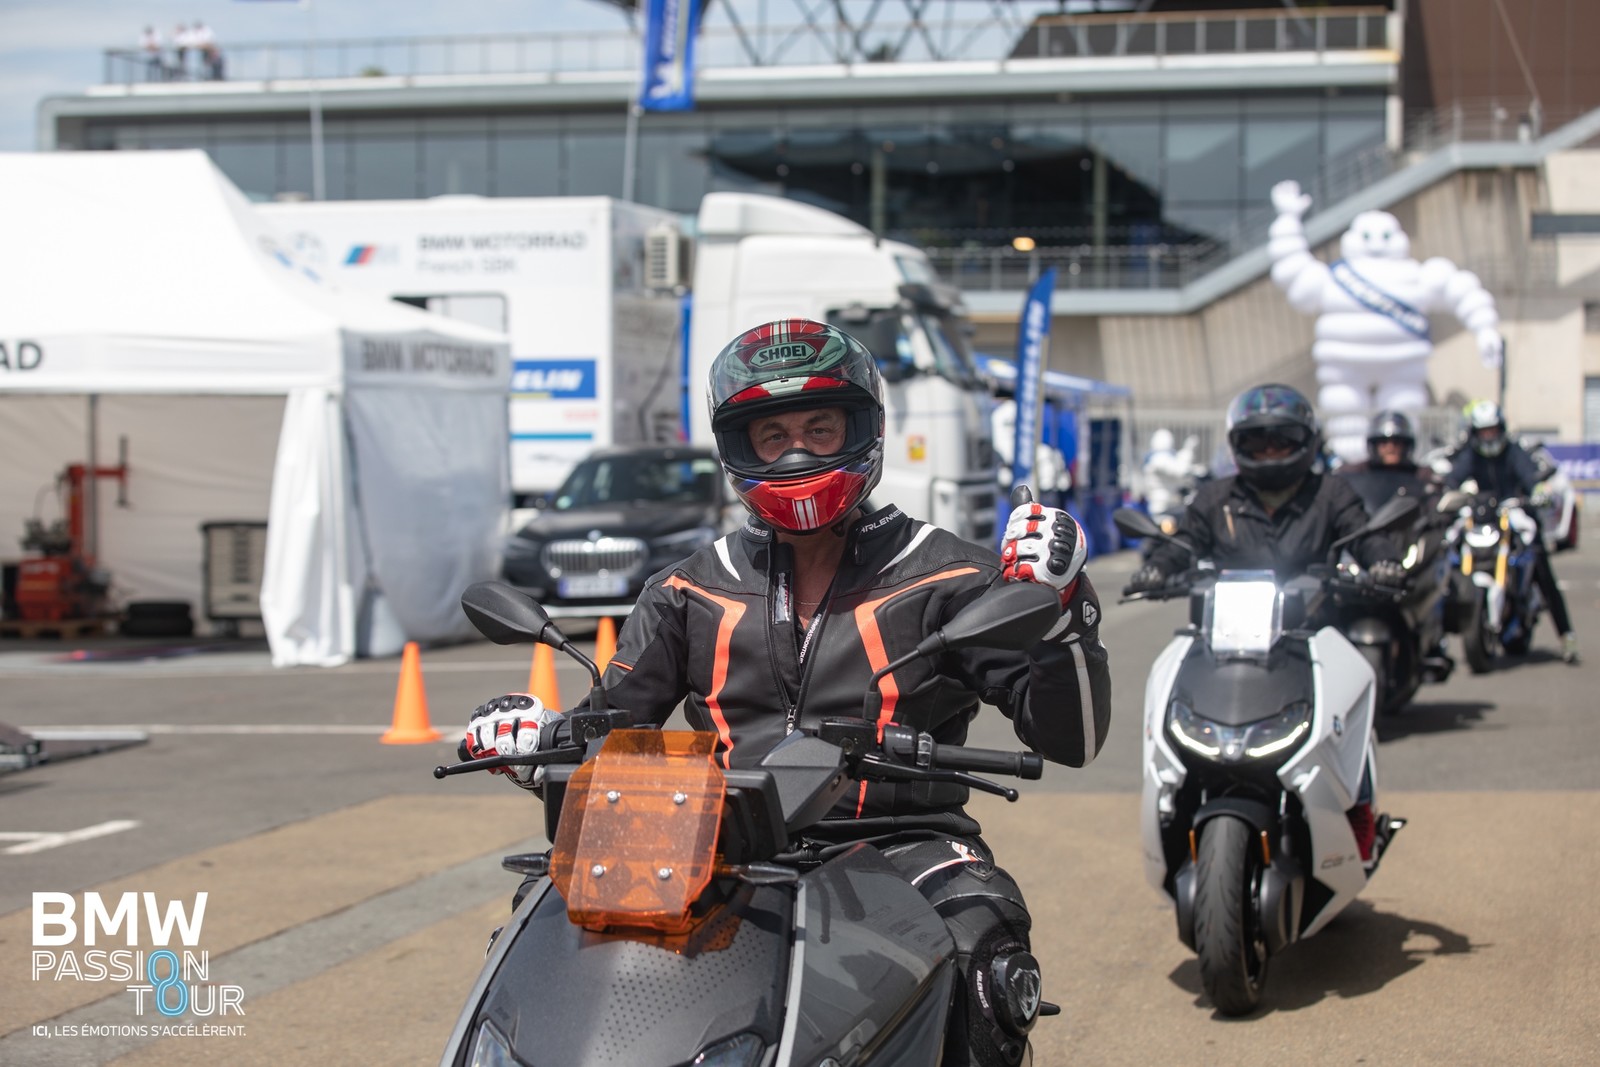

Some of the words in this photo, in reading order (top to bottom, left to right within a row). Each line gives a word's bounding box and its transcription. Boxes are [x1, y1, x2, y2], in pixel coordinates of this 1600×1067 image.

[361, 338, 403, 372] BMW
[411, 341, 496, 377] MOTORRAD
[758, 345, 807, 363] SHOEI
